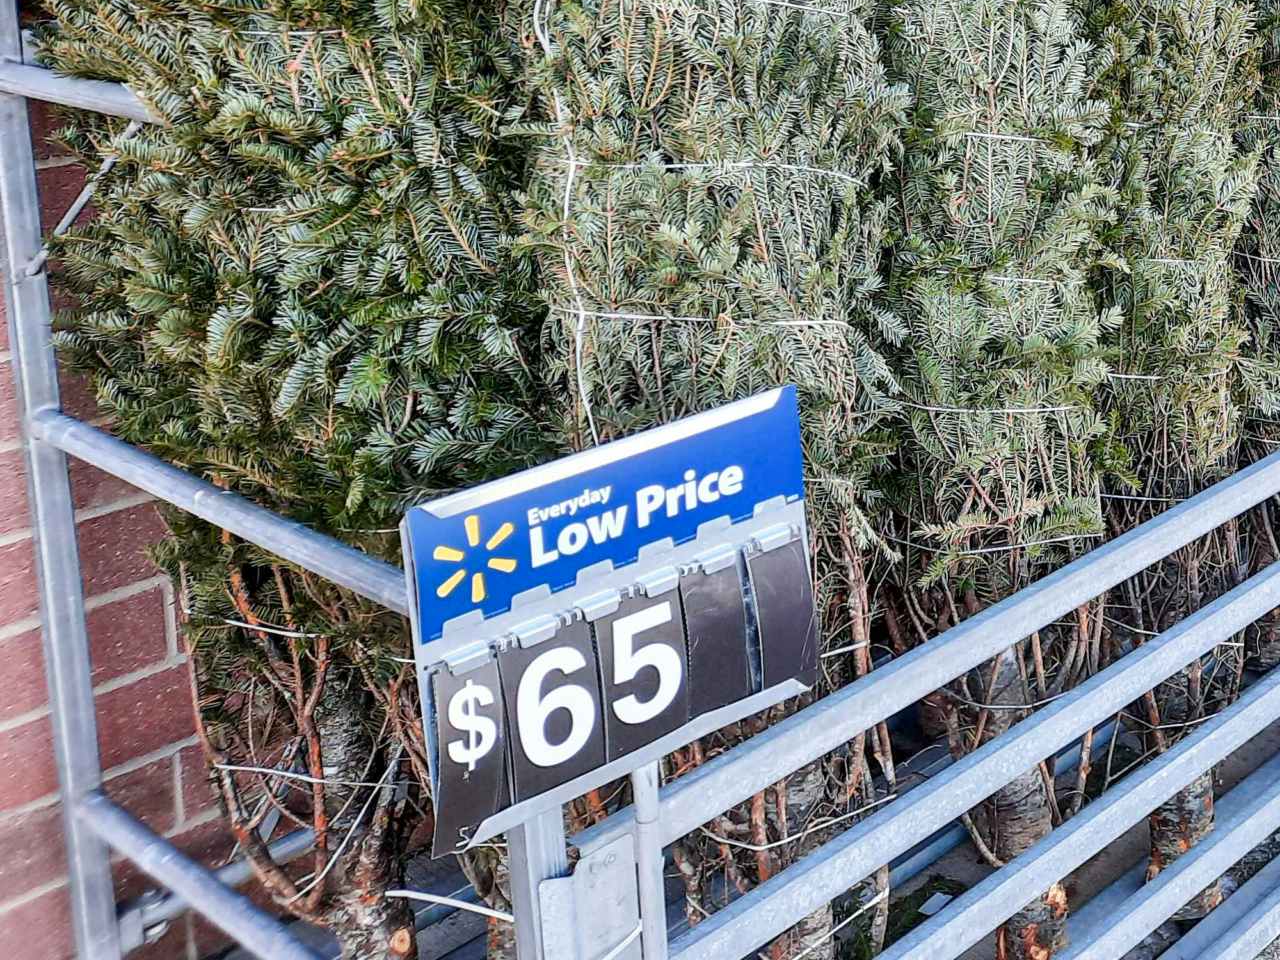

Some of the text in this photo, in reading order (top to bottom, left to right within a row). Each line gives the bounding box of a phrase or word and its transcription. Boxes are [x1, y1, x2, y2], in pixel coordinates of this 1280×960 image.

[527, 485, 612, 525] Everyday
[529, 465, 744, 568] Low Price
[447, 601, 683, 771] $65
